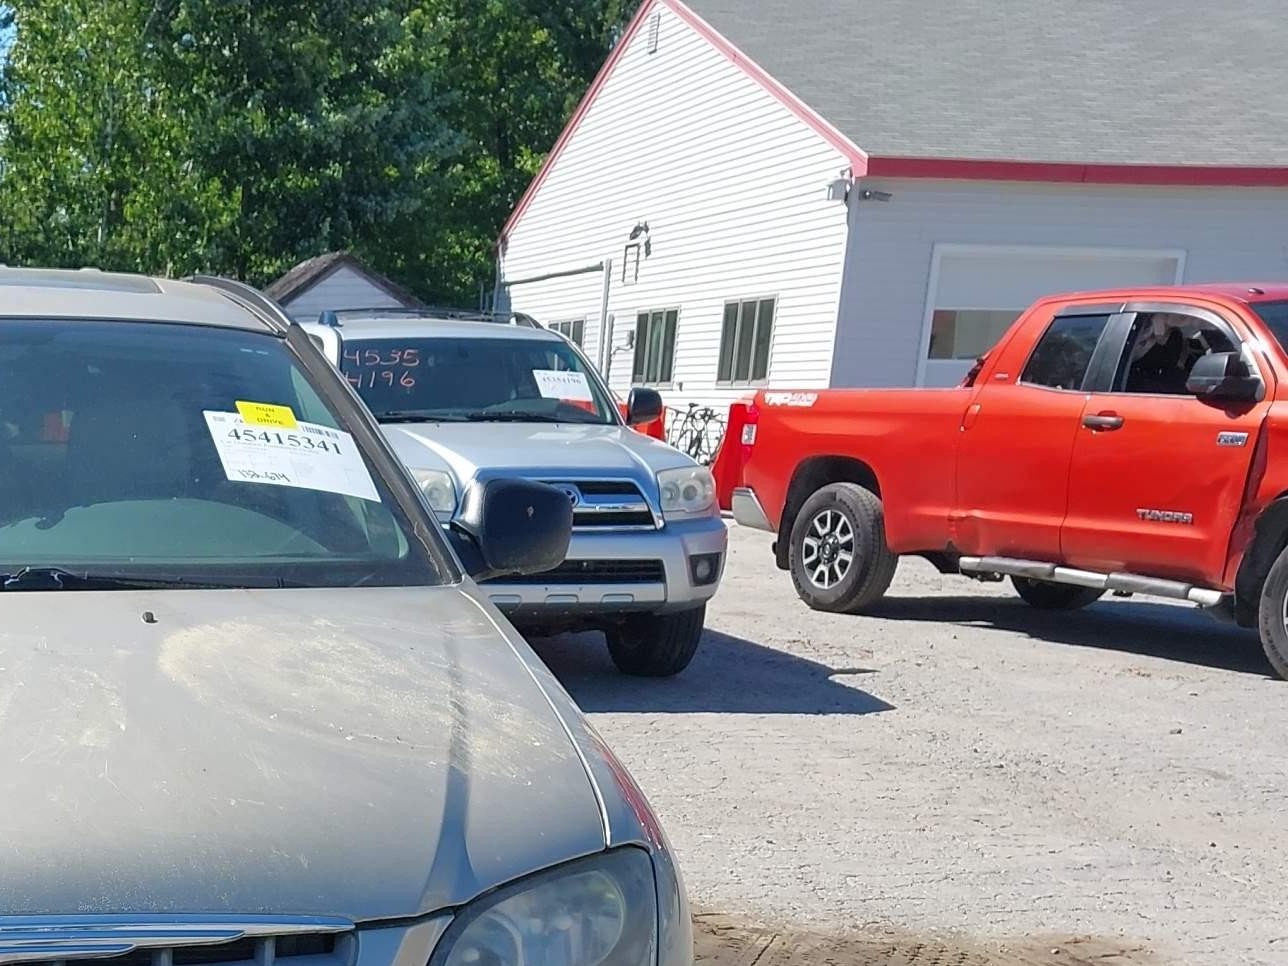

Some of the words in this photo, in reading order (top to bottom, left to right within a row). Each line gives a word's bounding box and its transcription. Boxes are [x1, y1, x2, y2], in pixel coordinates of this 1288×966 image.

[343, 348, 420, 367] 4535
[343, 370, 416, 389] 4196
[227, 428, 343, 455] 45415341
[1136, 508, 1193, 524] TUNDRA
